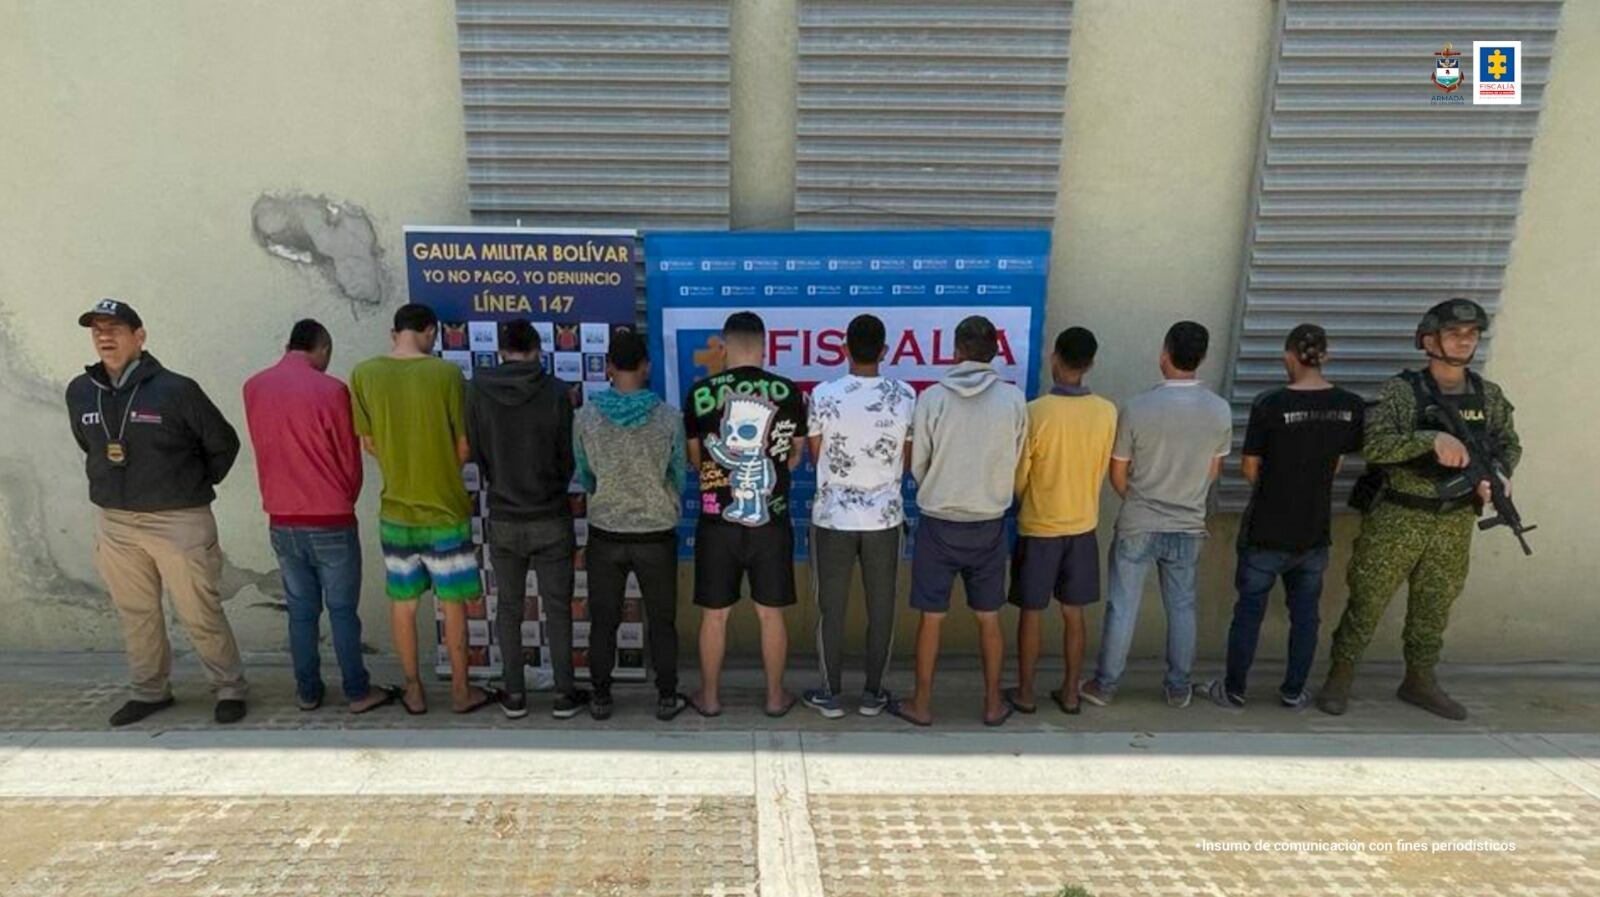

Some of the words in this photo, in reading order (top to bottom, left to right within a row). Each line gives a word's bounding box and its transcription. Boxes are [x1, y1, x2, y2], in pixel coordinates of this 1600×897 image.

[413, 243, 476, 260] GAULA
[482, 244, 547, 261] MILITAR
[553, 241, 628, 263] BOLÍVAR
[423, 270, 444, 283] YO
[449, 270, 470, 283] NO
[475, 271, 520, 285] PAGO,
[524, 272, 543, 284] YO
[548, 272, 621, 286] DENUNCIO
[474, 290, 532, 313] LÍNEA
[539, 296, 574, 313] 147
[768, 329, 1017, 367] FISALA
[82, 412, 99, 425] CTI
